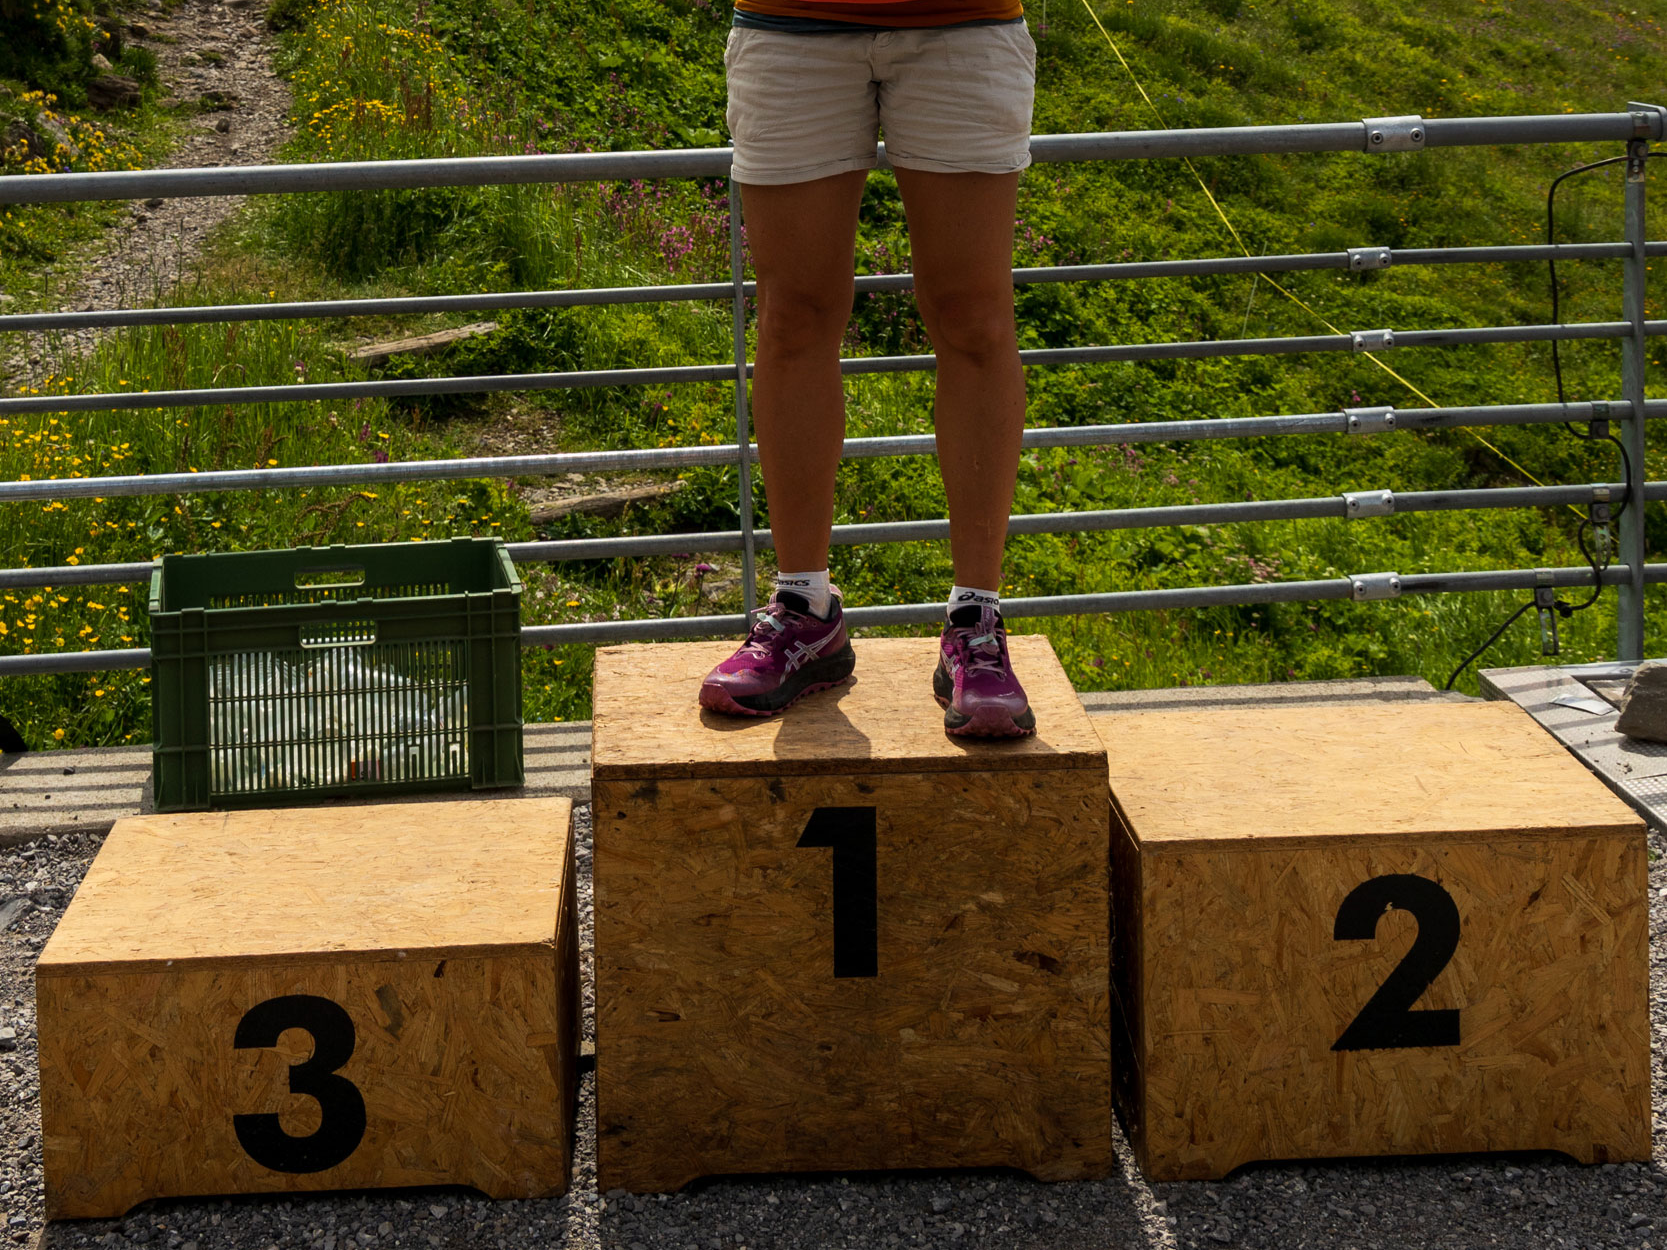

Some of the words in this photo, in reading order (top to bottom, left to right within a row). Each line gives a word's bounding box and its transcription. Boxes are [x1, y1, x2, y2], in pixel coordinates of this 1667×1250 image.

[796, 806, 878, 978] 1
[1331, 874, 1460, 1052] 2
[233, 995, 367, 1175] 3
